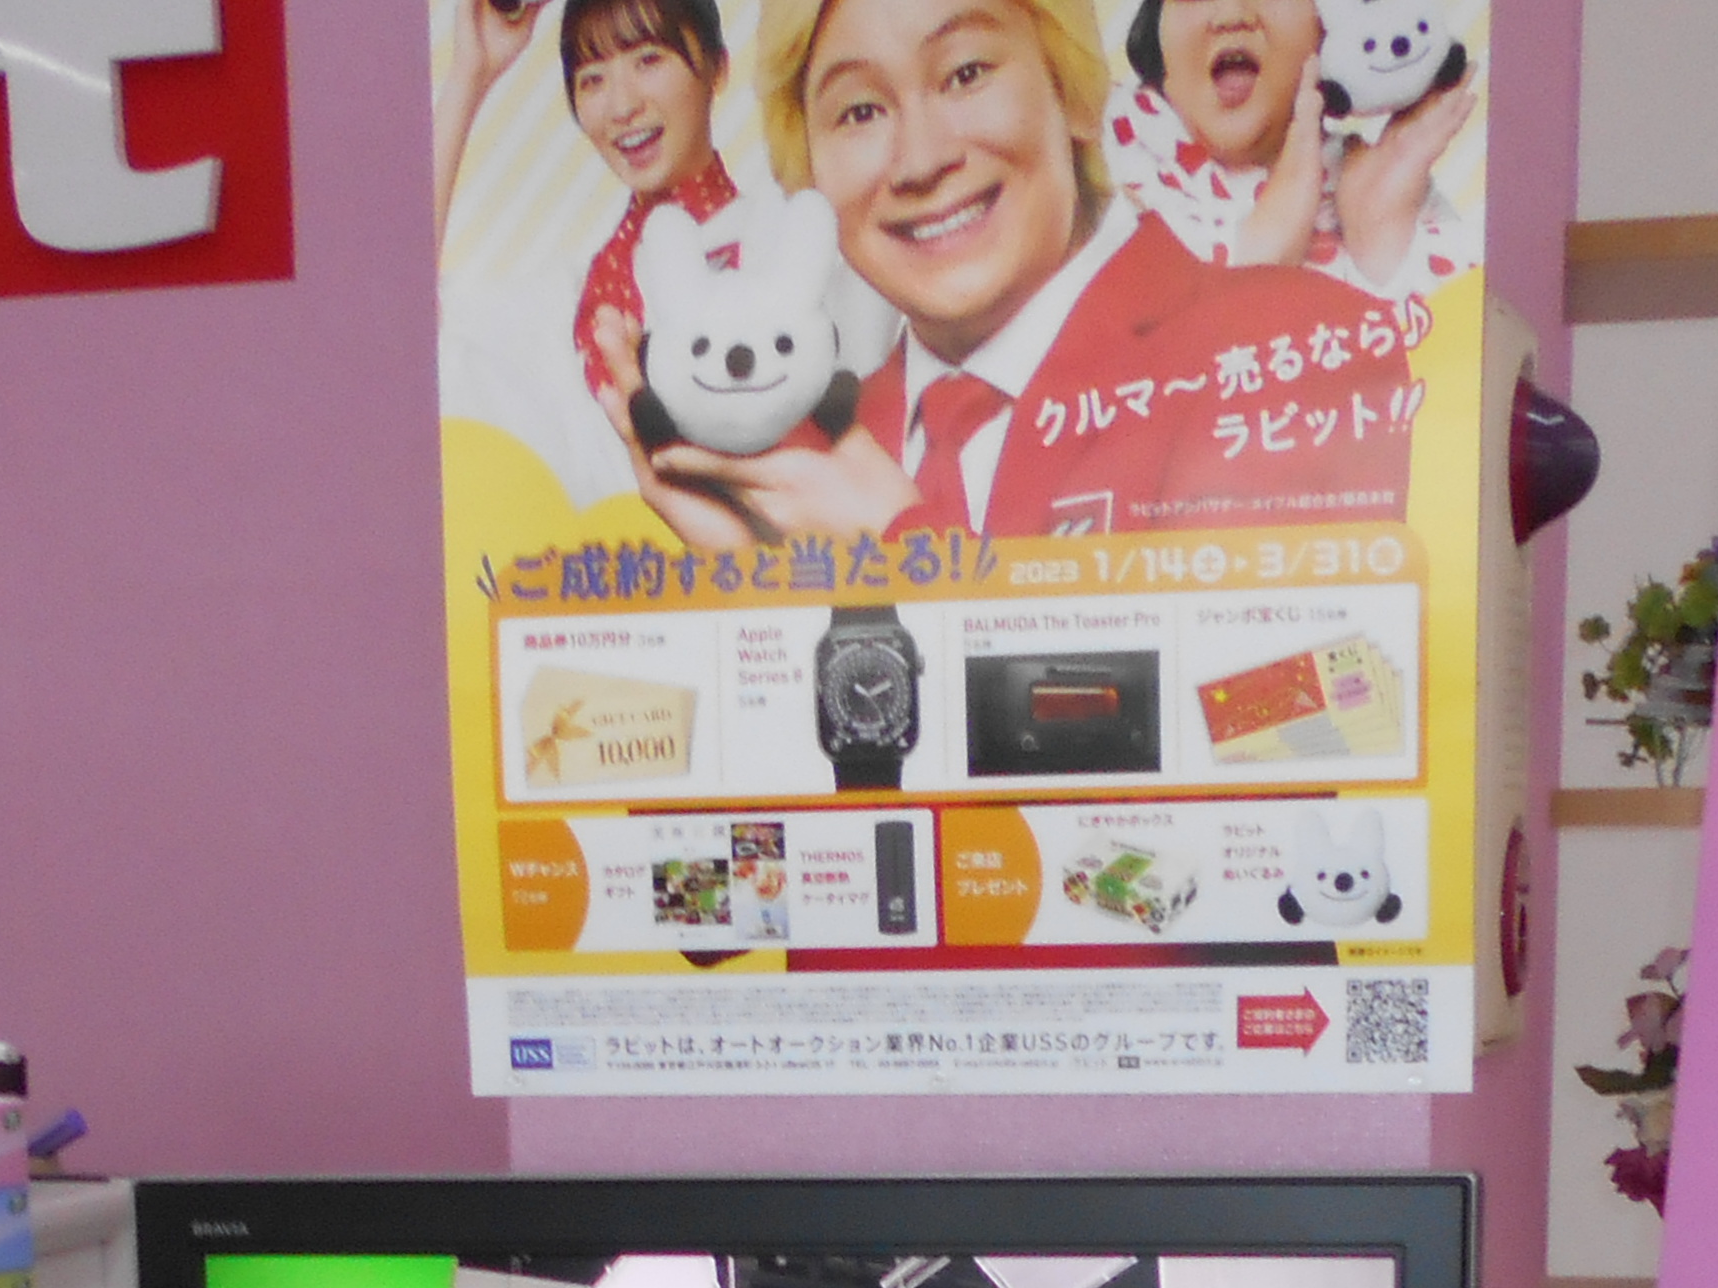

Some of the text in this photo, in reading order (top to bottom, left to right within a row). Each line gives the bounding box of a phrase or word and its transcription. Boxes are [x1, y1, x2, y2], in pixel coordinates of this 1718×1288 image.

[1010, 560, 1079, 585] 2023
[964, 612, 1160, 633] BALMUDA The Toaster Pro
[739, 627, 783, 643] Apple
[739, 648, 787, 662] Watch
[739, 670, 789, 684] Series
[597, 736, 676, 767] 10,000
[800, 850, 864, 865] THERMOS
[192, 1221, 250, 1238] BRAVIA
